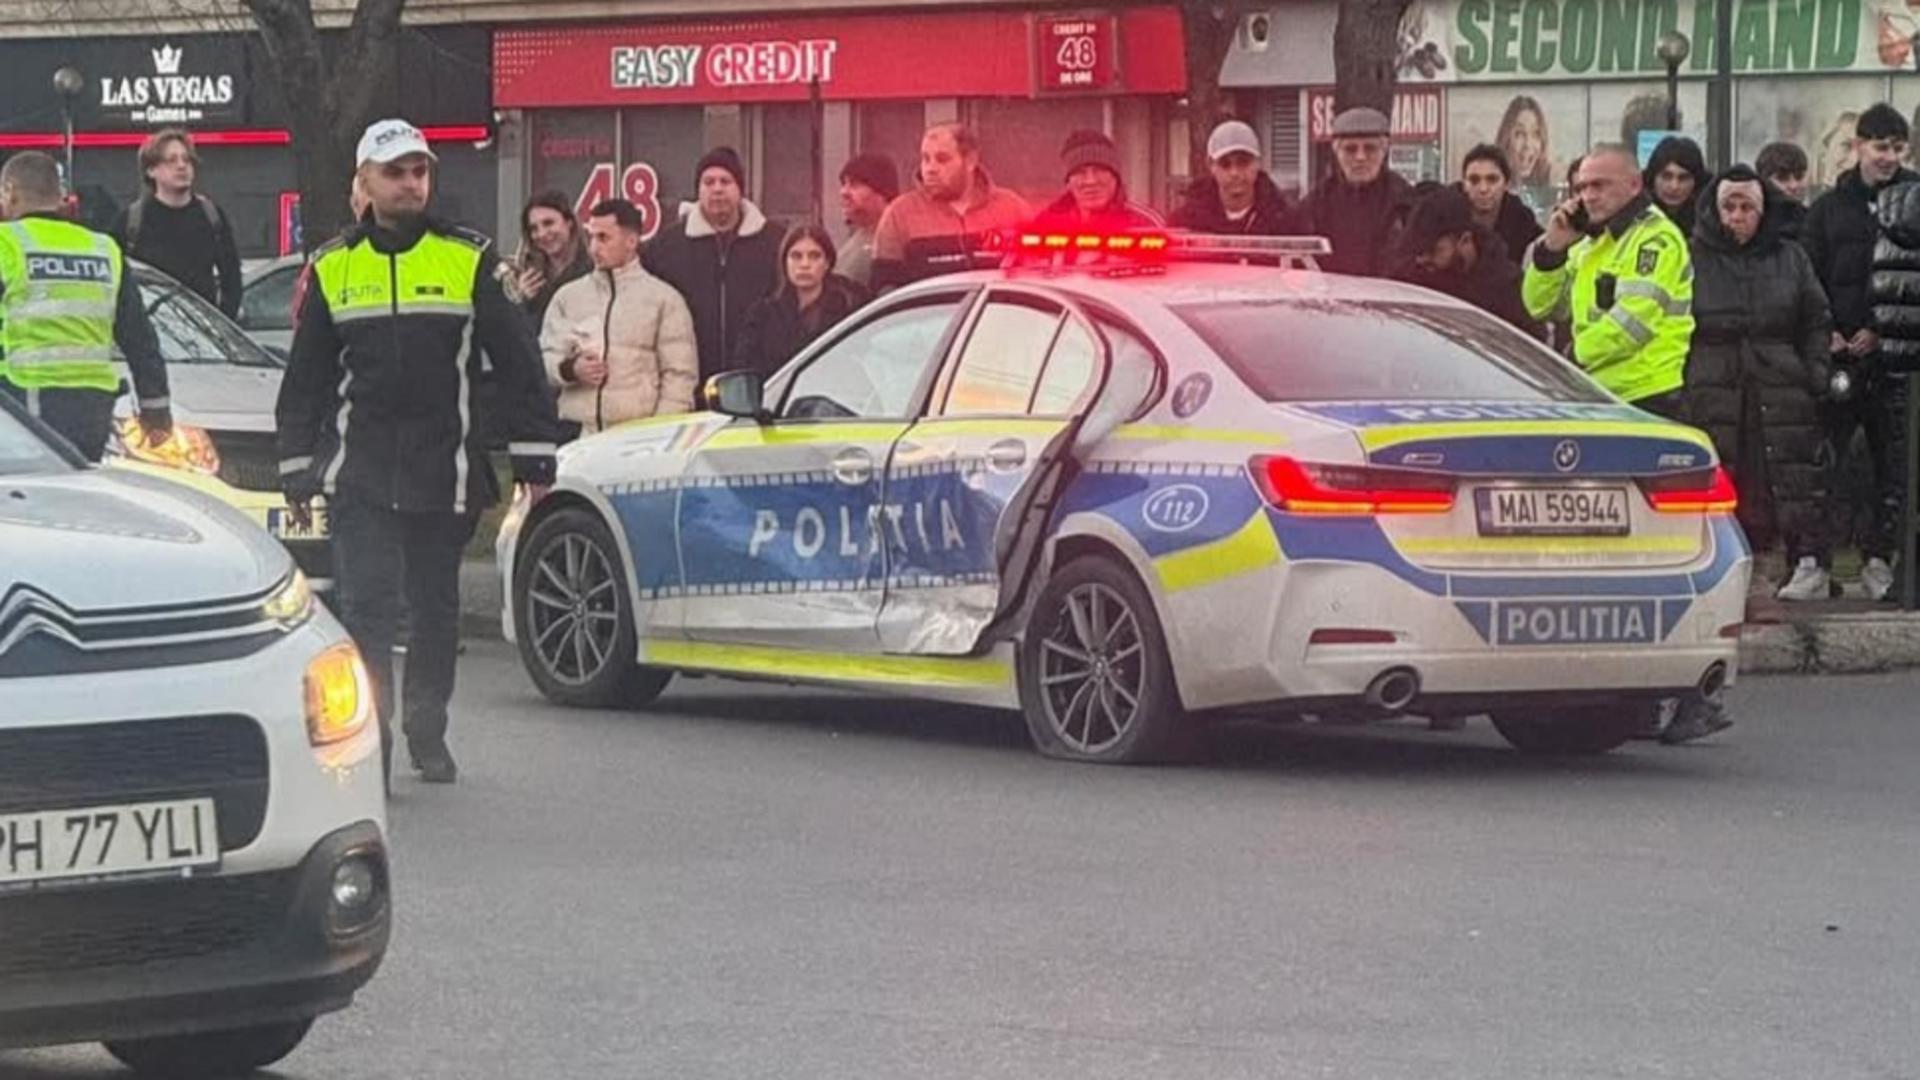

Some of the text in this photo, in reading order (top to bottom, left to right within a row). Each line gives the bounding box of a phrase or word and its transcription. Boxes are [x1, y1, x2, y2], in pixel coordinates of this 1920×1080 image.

[1056, 36, 1096, 69] 48
[1455, 0, 1861, 74] SECOND HAND
[611, 40, 837, 88] EASY CREDIT
[101, 75, 233, 105] LAS VEGAS
[146, 105, 187, 122] Games
[574, 163, 661, 241] 48
[28, 256, 109, 277] POLITIA
[1163, 501, 1195, 522] 112
[1498, 493, 1620, 523] MAI 59944
[749, 499, 965, 558] POLITIA
[1507, 606, 1645, 640] POLITIA
[0, 804, 203, 873] H 77 YLI
